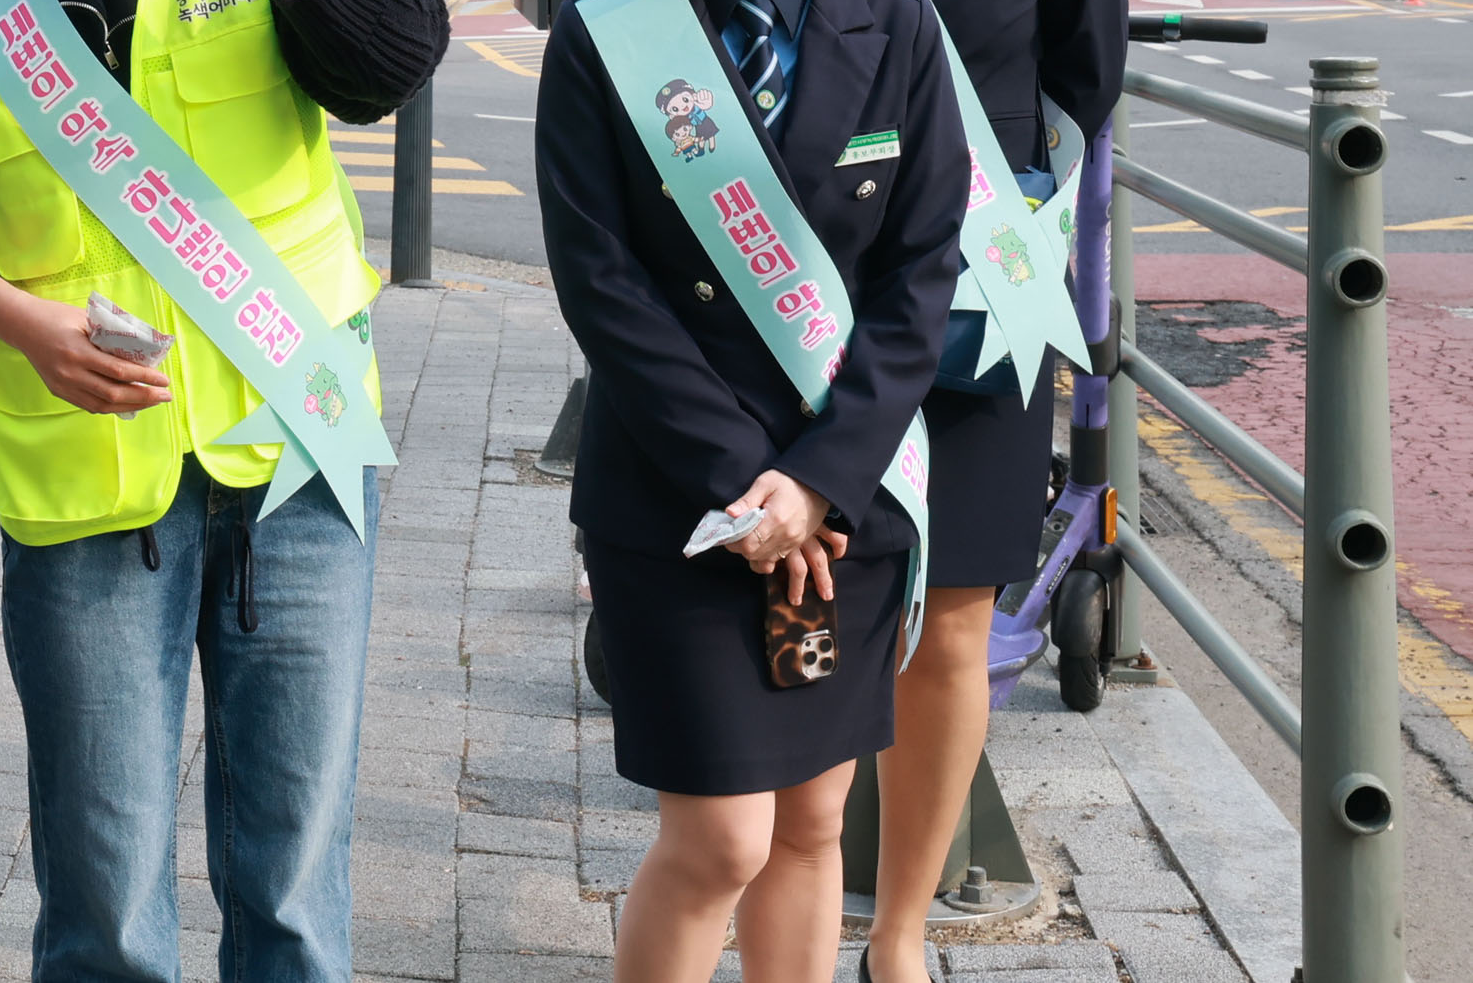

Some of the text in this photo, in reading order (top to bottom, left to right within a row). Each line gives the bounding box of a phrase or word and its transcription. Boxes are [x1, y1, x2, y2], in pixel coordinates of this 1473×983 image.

[60, 99, 136, 171] 약속
[123, 168, 251, 301] 하나뿐인
[237, 290, 302, 365] 안전
[712, 179, 797, 287] 세번의
[776, 282, 837, 349] 약속
